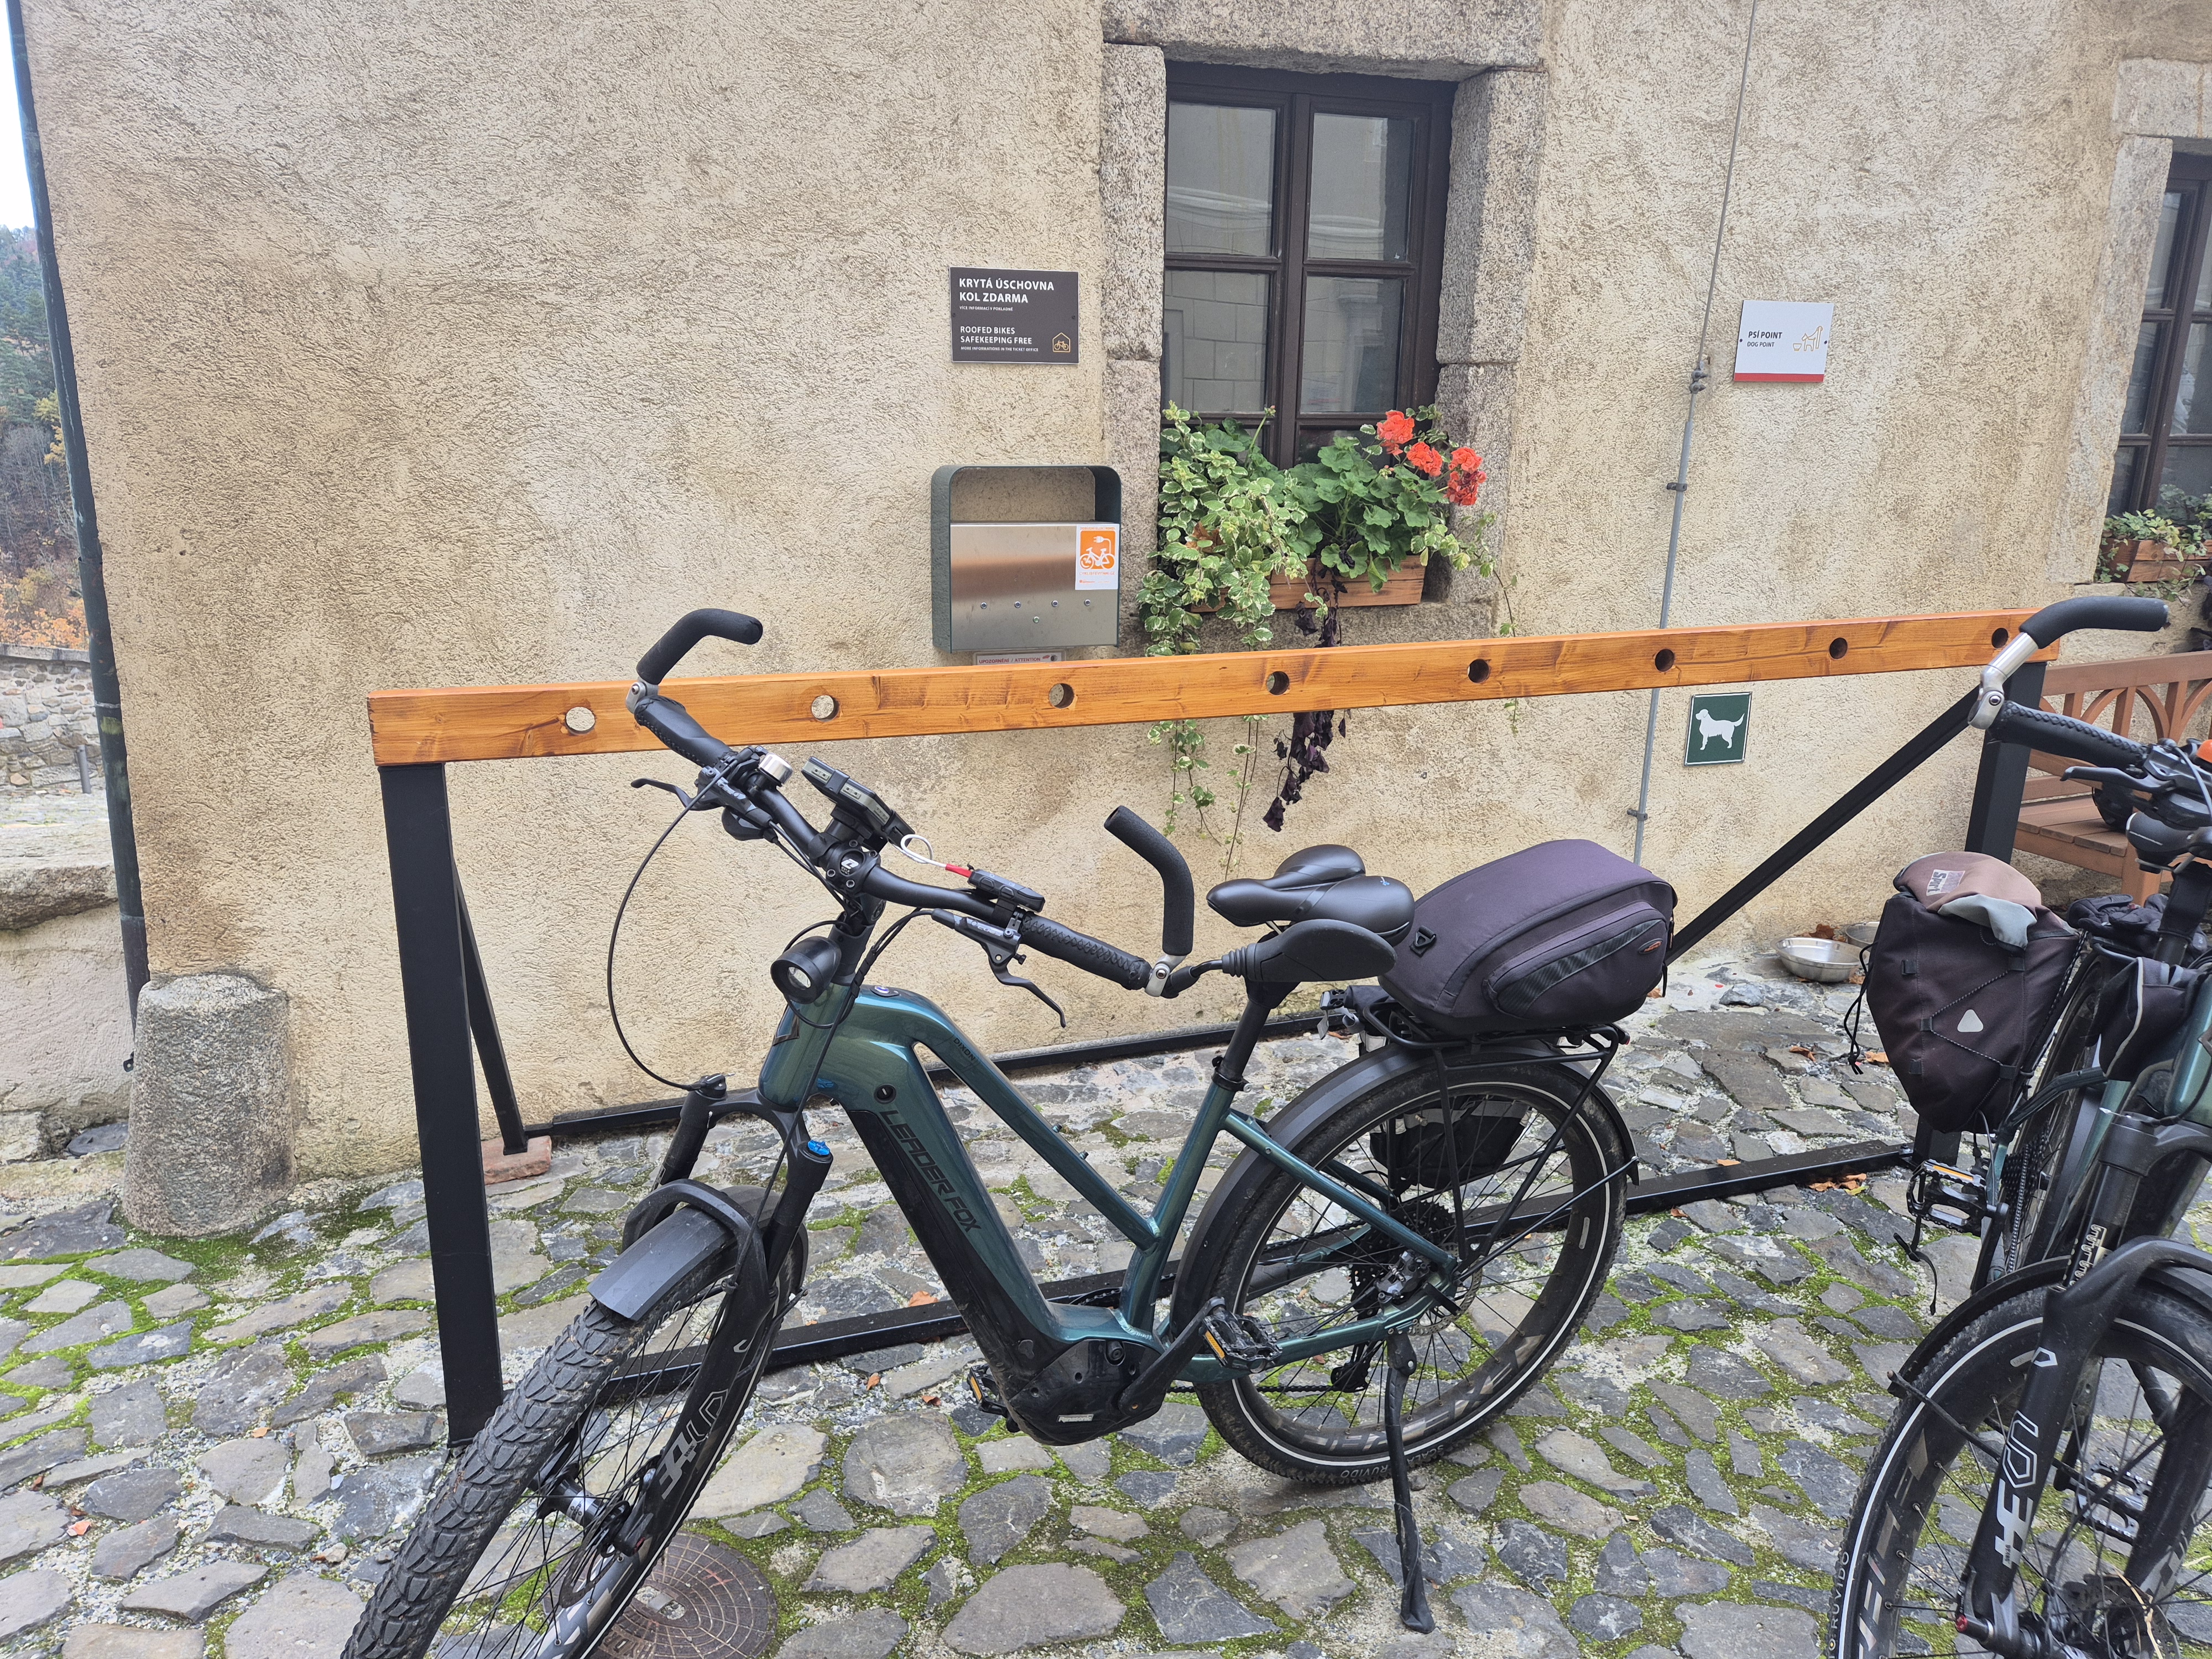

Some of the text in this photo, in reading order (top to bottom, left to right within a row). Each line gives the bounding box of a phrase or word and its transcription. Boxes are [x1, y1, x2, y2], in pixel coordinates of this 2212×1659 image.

[959, 277, 1055, 291] KRYTÁ ÚSCHOVNA
[959, 292, 1029, 303] KOL ZDARMA
[960, 336, 1012, 344] SAFEKEEPING
[1748, 330, 1760, 338] PSÍ
[953, 1037, 976, 1061] DIXON
[879, 1110, 982, 1233] LEADER FOX
[1340, 1464, 1389, 1479] RUVIDO
[1830, 1551, 1850, 1629] RUVIDO
